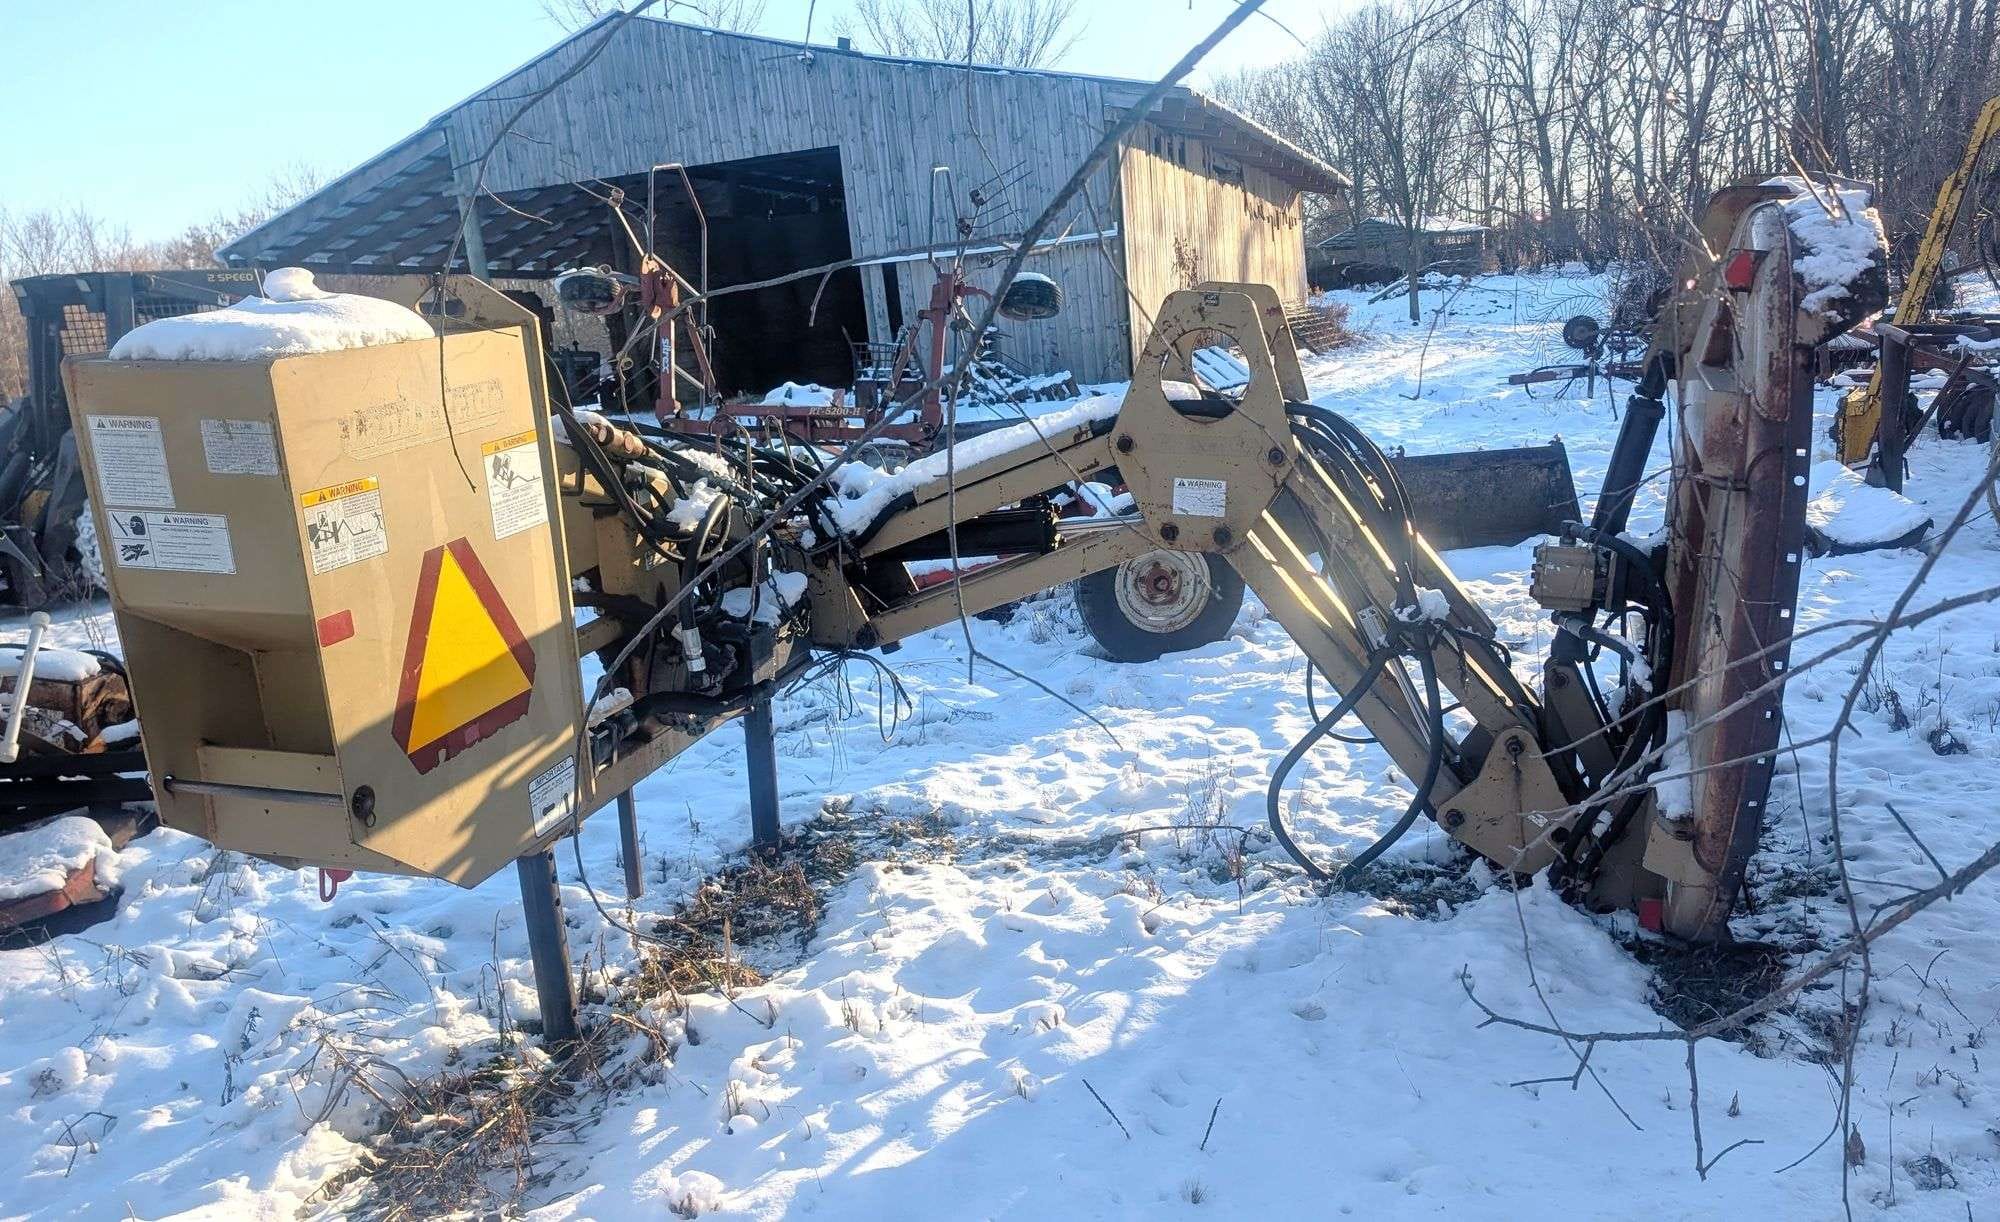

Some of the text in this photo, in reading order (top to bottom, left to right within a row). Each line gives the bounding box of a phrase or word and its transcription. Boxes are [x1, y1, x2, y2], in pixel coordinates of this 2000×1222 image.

[208, 273, 253, 282] 2 SPEED
[109, 419, 152, 429] WARNING
[329, 482, 363, 497] WARNING
[1187, 480, 1223, 489] WARNING
[172, 516, 209, 526] WARNING
